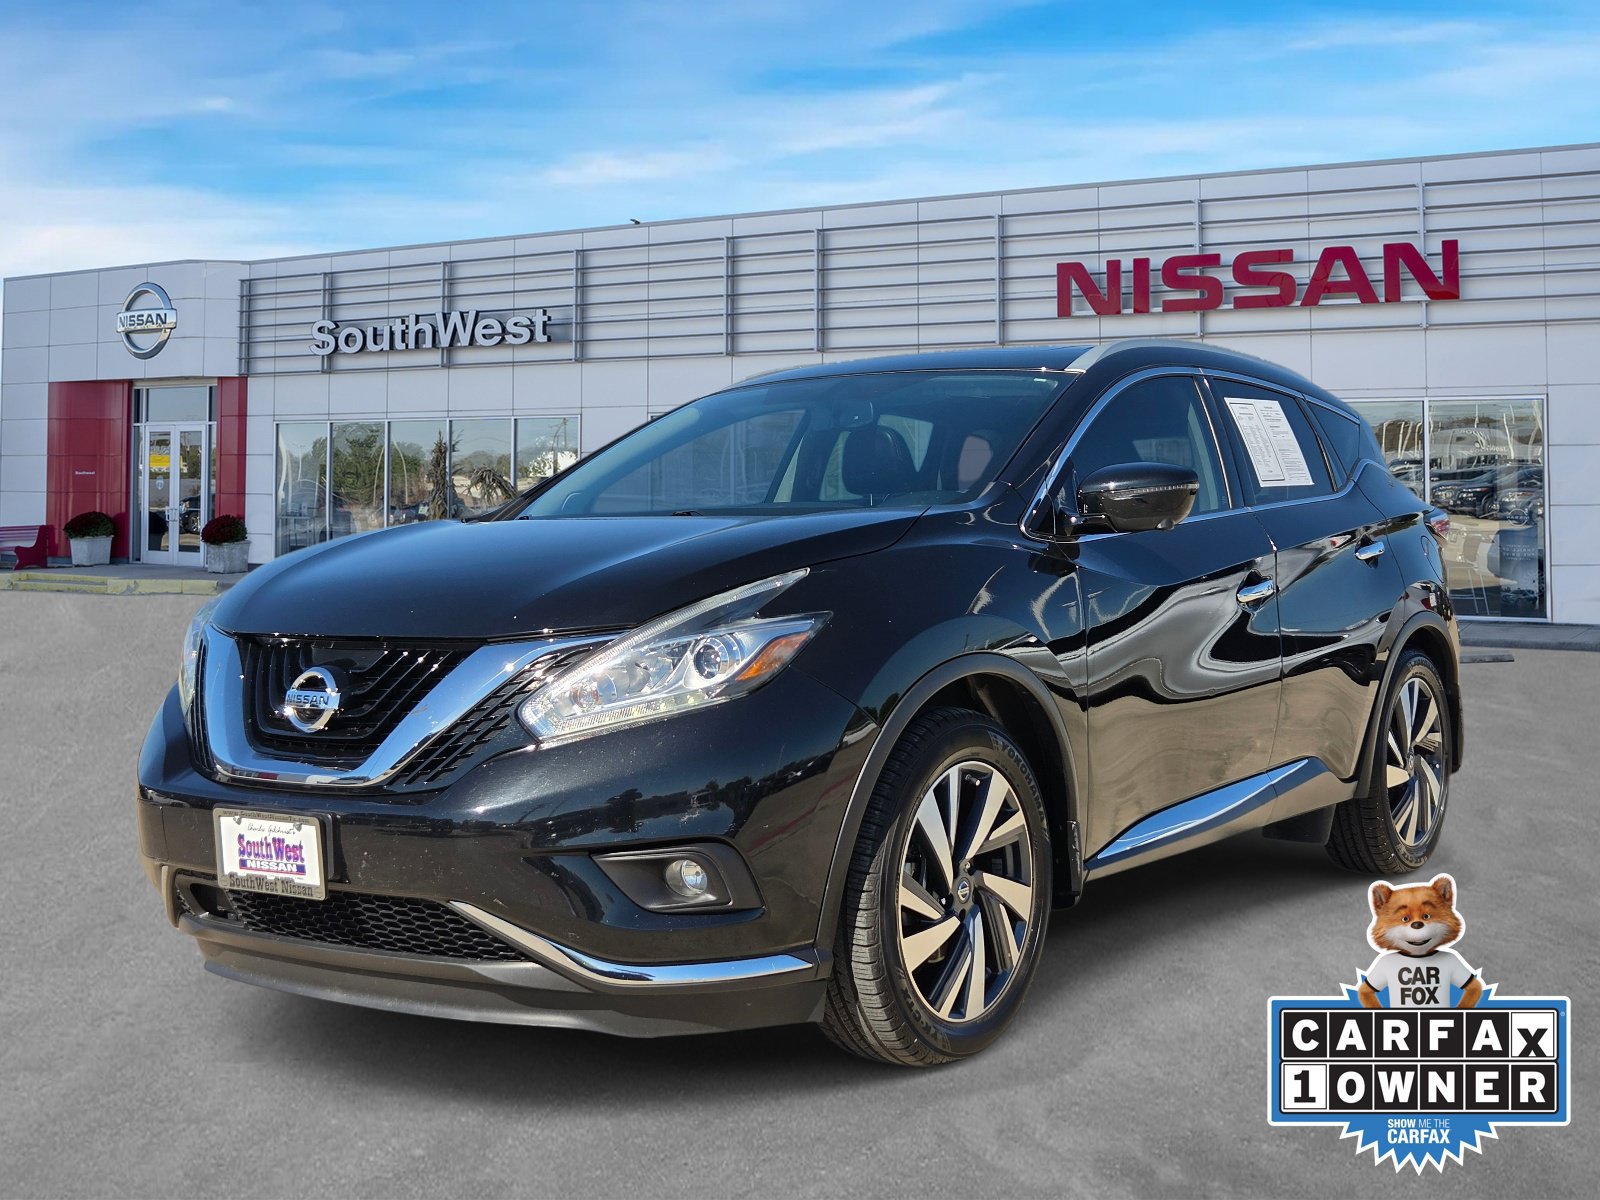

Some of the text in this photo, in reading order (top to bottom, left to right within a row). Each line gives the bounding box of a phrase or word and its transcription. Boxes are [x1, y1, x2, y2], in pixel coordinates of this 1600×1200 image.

[1057, 239, 1460, 317] NISSAN
[119, 313, 167, 328] NISSAN
[309, 308, 551, 356] SouthWest
[286, 693, 330, 706] NISSAN
[237, 833, 305, 863] SouthWest
[246, 859, 298, 873] NISSAN
[229, 874, 313, 897] SouthWest Nissan
